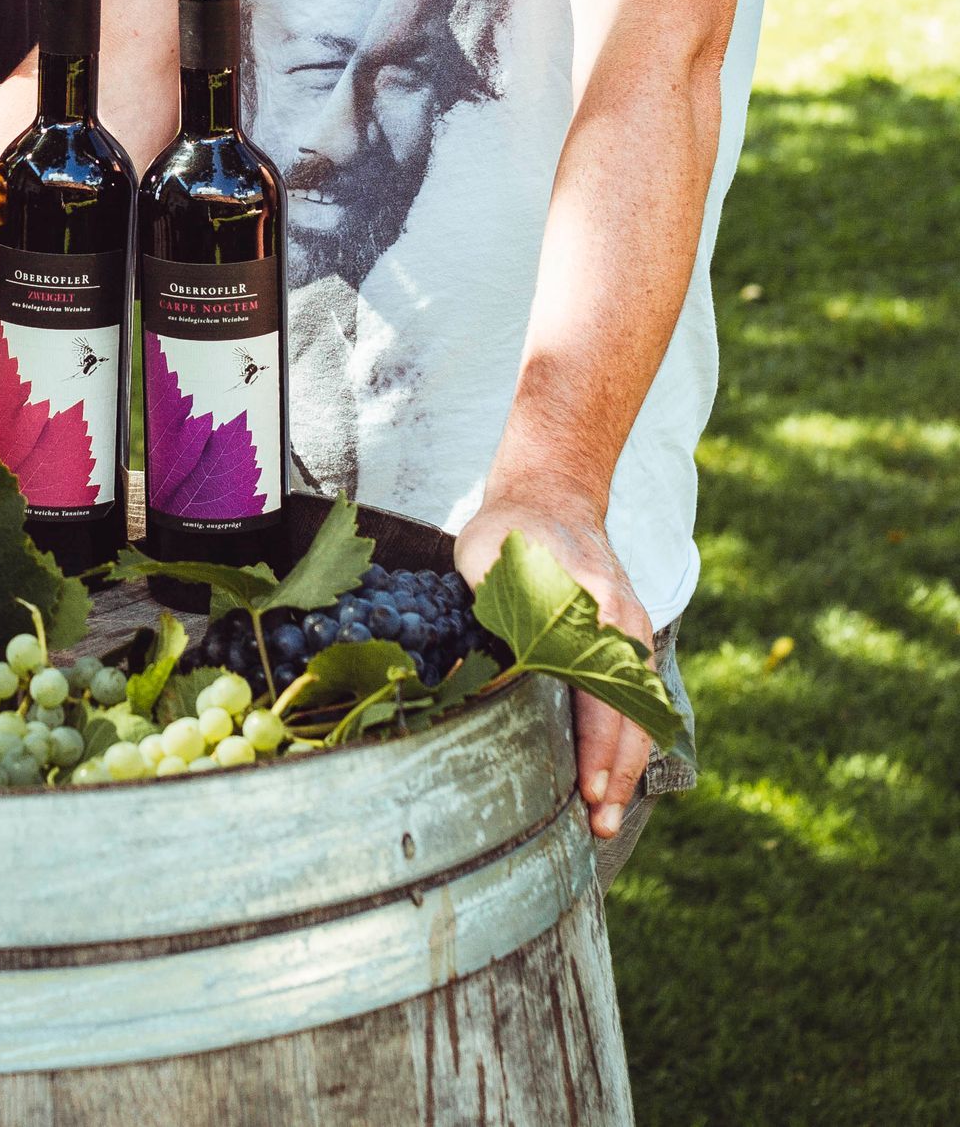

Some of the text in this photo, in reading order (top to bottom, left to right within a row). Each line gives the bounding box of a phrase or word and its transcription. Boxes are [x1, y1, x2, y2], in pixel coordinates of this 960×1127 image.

[14, 269, 90, 285] OBERKOFLER
[169, 282, 247, 295] OBERKOFLER
[27, 290, 75, 303] ZWEIGELT
[22, 302, 62, 312] biologischem
[159, 300, 259, 314] CARPE NOCTEM
[178, 315, 220, 324] biologischem
[222, 315, 249, 323] Weinbau
[206, 521, 242, 530] ausgeprägt
